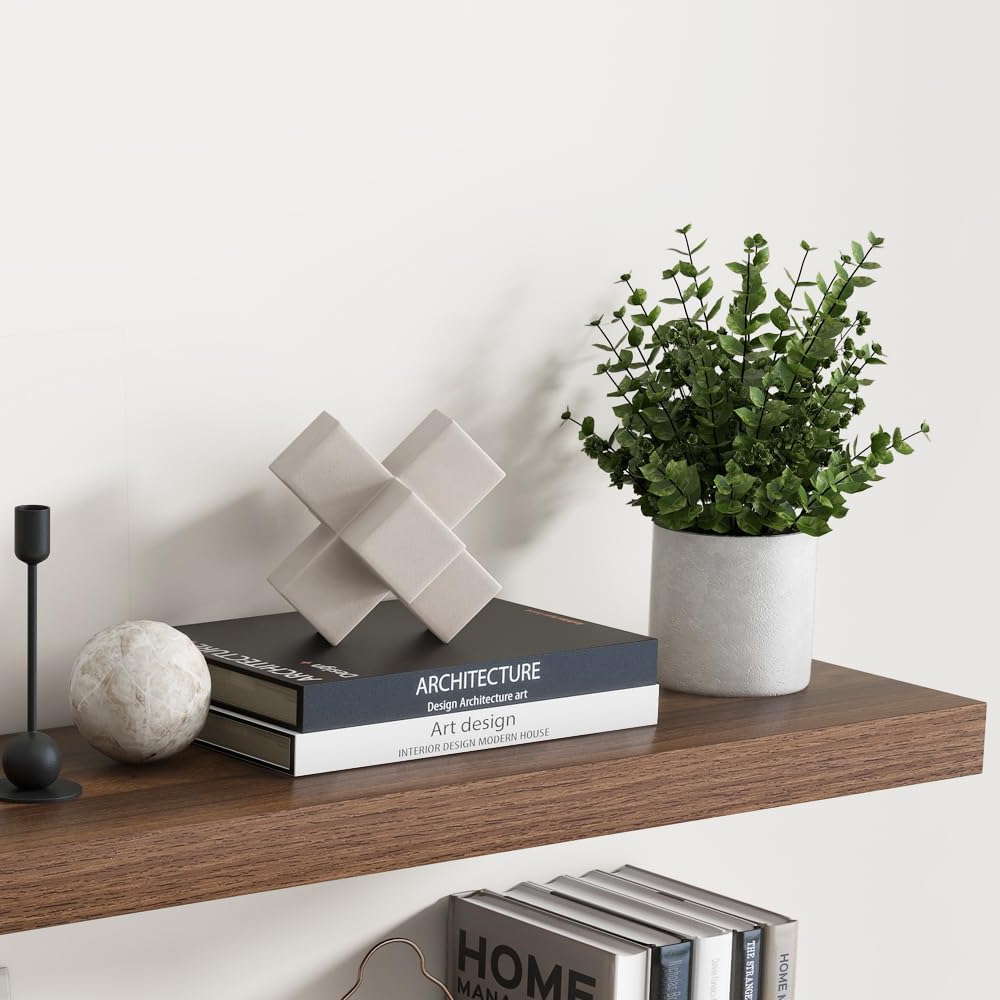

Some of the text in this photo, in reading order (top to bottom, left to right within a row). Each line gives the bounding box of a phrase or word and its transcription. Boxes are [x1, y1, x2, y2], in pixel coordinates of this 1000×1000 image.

[415, 661, 541, 696] ARCHITECTURE
[427, 690, 528, 712] Design Architecture art
[430, 714, 516, 737] Art design
[398, 728, 550, 758] INTERIOR DESIGN MODERN HOUSE
[746, 940, 756, 959] THE
[778, 953, 789, 991] HOME
